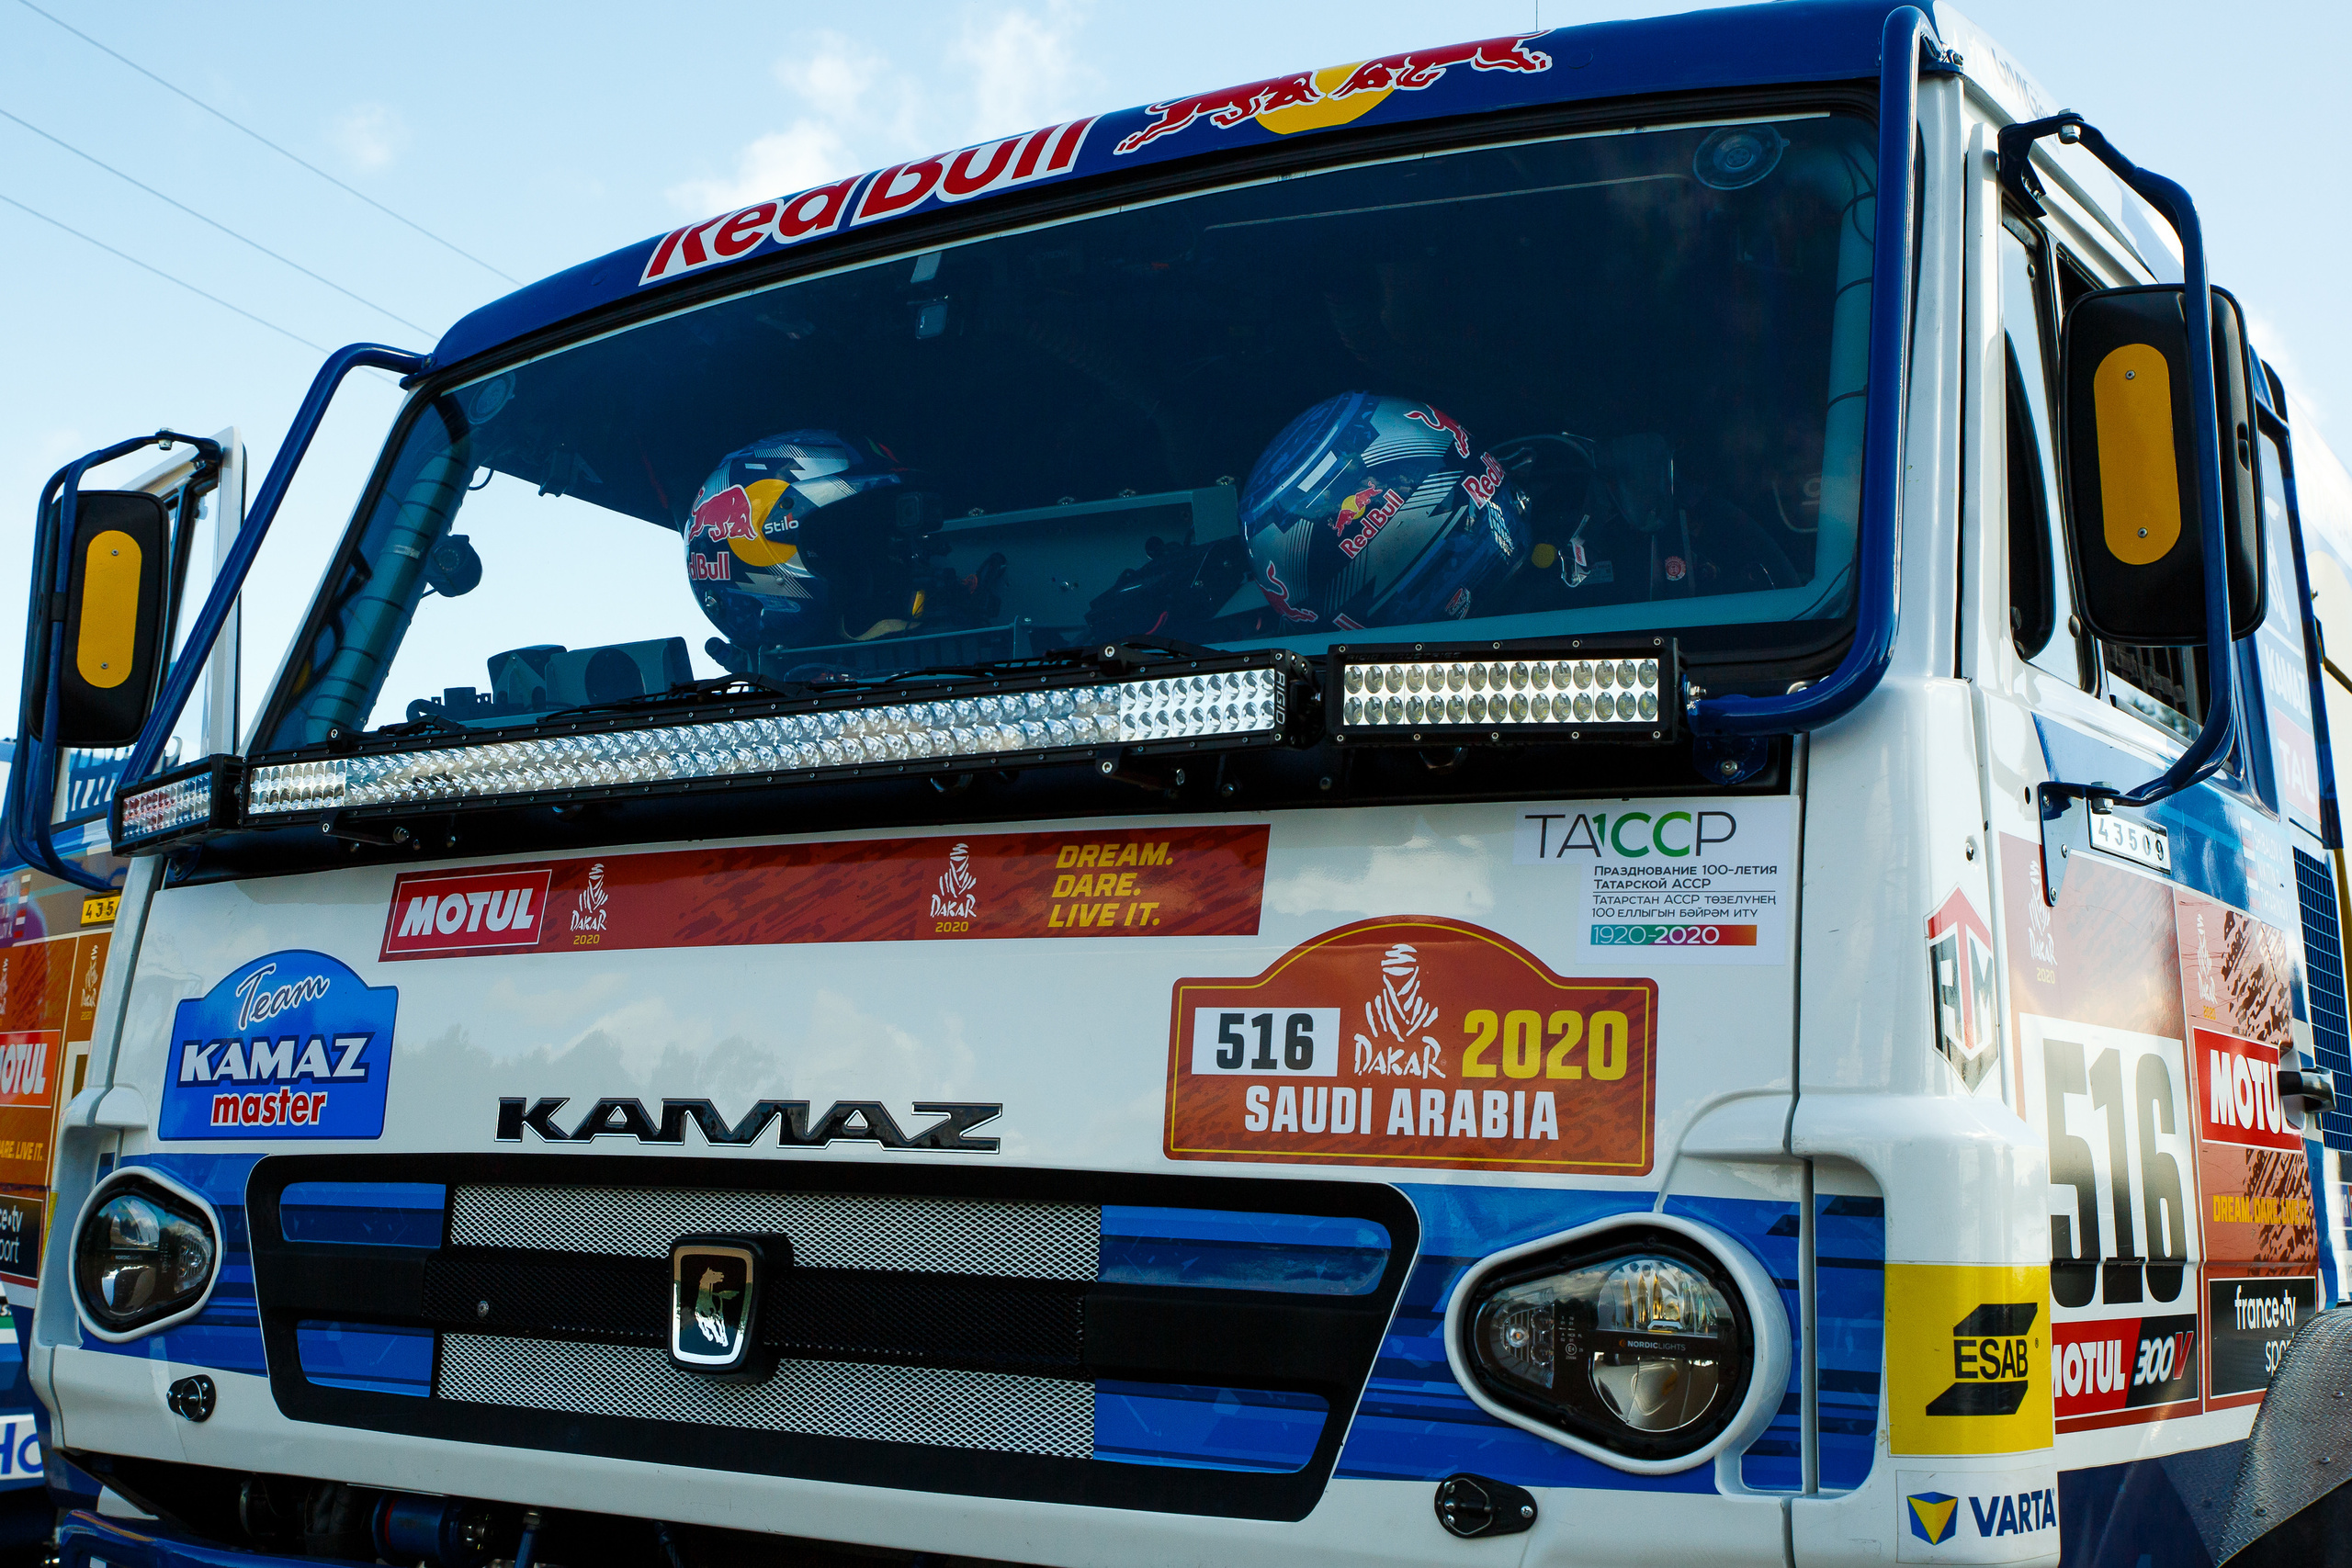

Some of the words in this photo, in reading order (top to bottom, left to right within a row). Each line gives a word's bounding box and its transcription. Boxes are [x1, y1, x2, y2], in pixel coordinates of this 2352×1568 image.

[639, 173, 869, 286] Red
[851, 114, 1106, 226] Bull
[1461, 455, 1502, 510] Red
[1339, 517, 1379, 559] Red
[1366, 489, 1405, 529] Bull
[695, 551, 731, 581] Bull
[1275, 671, 1286, 725] RIGID
[1056, 841, 1173, 869] DREAM.
[2098, 818, 2165, 862] 43509
[1052, 874, 1142, 897] DARE.
[85, 900, 117, 919] 435
[398, 887, 536, 937] MOTUL
[935, 921, 968, 932] 2020
[1048, 902, 1120, 928] LIVE
[1124, 902, 1161, 927] IT.
[1592, 908, 1615, 918] 100
[573, 934, 600, 944] 2020
[1594, 925, 1720, 944] 1920-2020
[236, 963, 331, 1031] Team
[2036, 966, 2055, 985] 2020
[179, 1037, 369, 1083] KAMAZ
[1216, 1012, 1315, 1071] 516
[1461, 1009, 1629, 1081] 2020
[210, 1086, 328, 1126] master
[494, 1097, 1003, 1155] KAMAZ
[1244, 1085, 1373, 1135] SAUDI
[1387, 1088, 1560, 1141] ARABIA
[2043, 1037, 2188, 1308] 516
[2212, 1195, 2253, 1223] DREAM.
[1953, 1338, 2029, 1379] ESAB
[2133, 1330, 2195, 1387] 300V
[1968, 1488, 2056, 1538] VARTA
